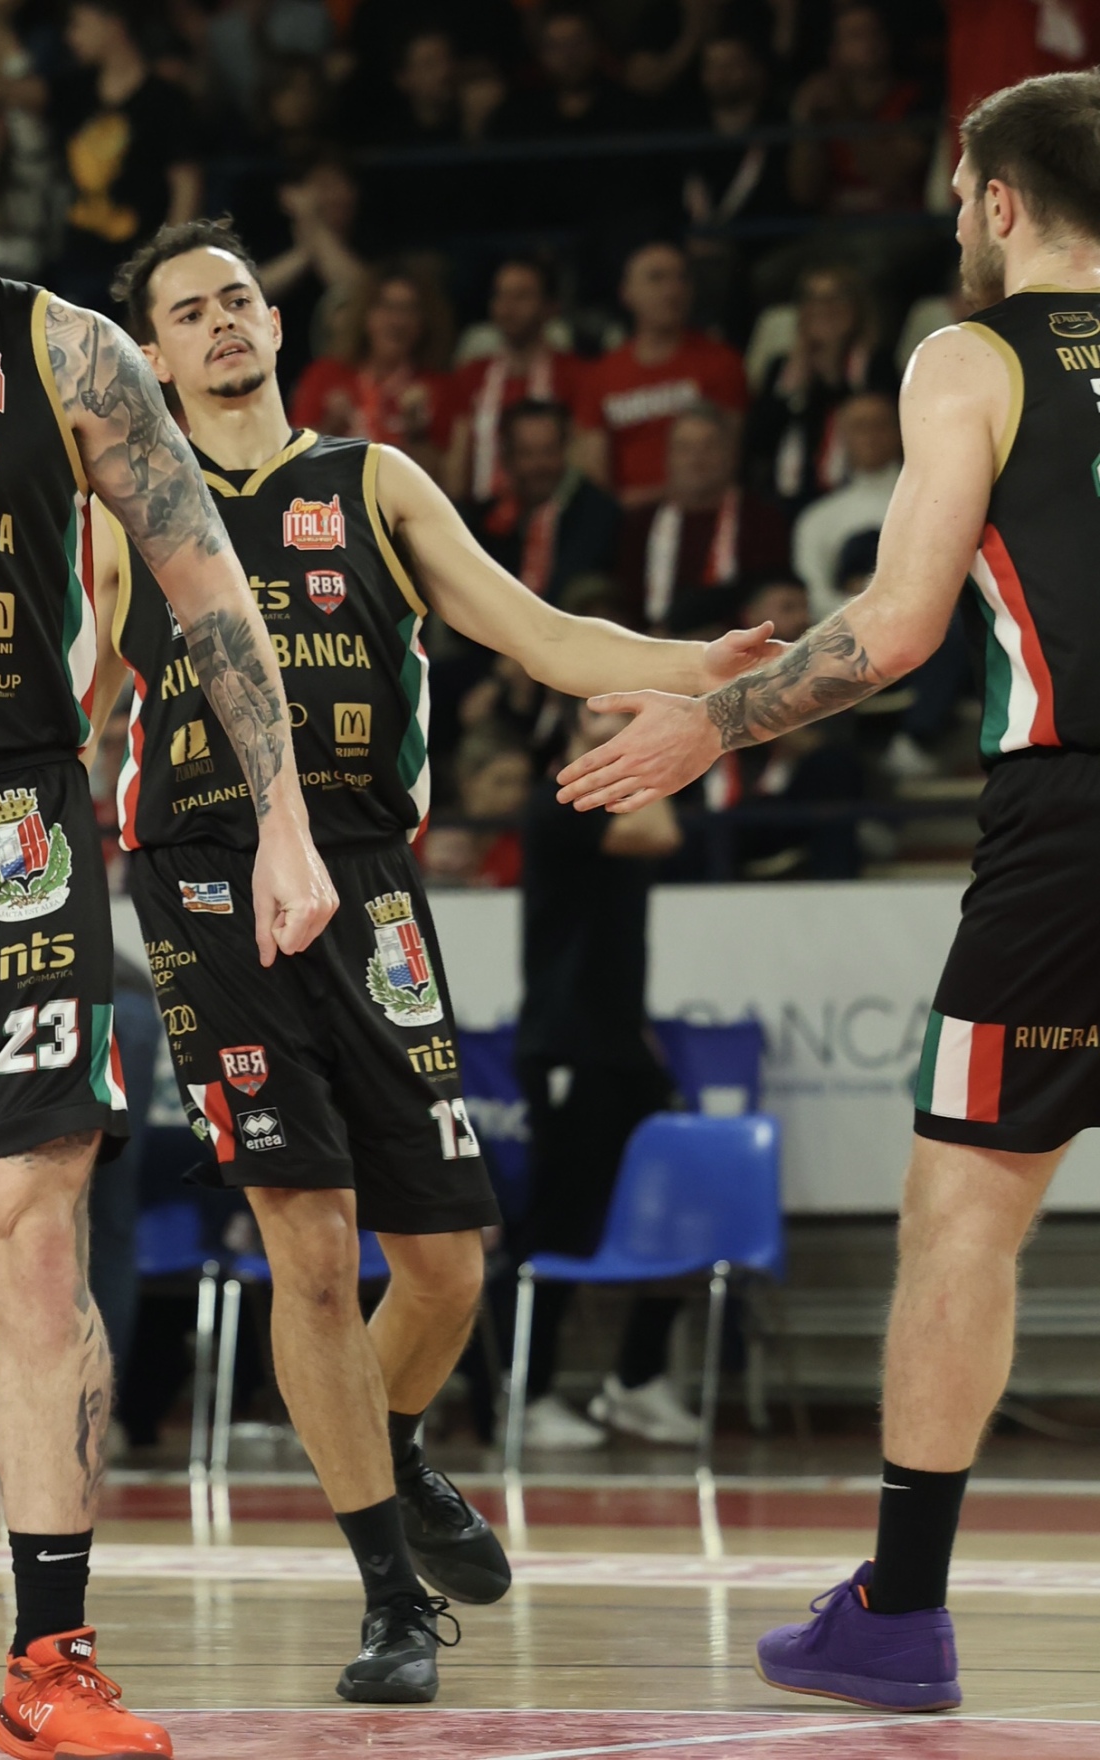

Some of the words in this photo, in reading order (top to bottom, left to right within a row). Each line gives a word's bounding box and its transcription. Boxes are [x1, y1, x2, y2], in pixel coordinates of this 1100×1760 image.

[1055, 345, 1100, 371] RIV
[286, 514, 341, 542] ITALIA
[249, 576, 290, 610] ts
[172, 786, 238, 814] ITALIAN
[0, 931, 75, 981] nts
[1015, 1024, 1099, 1050] RIVIERA
[245, 1134, 282, 1150] errea
